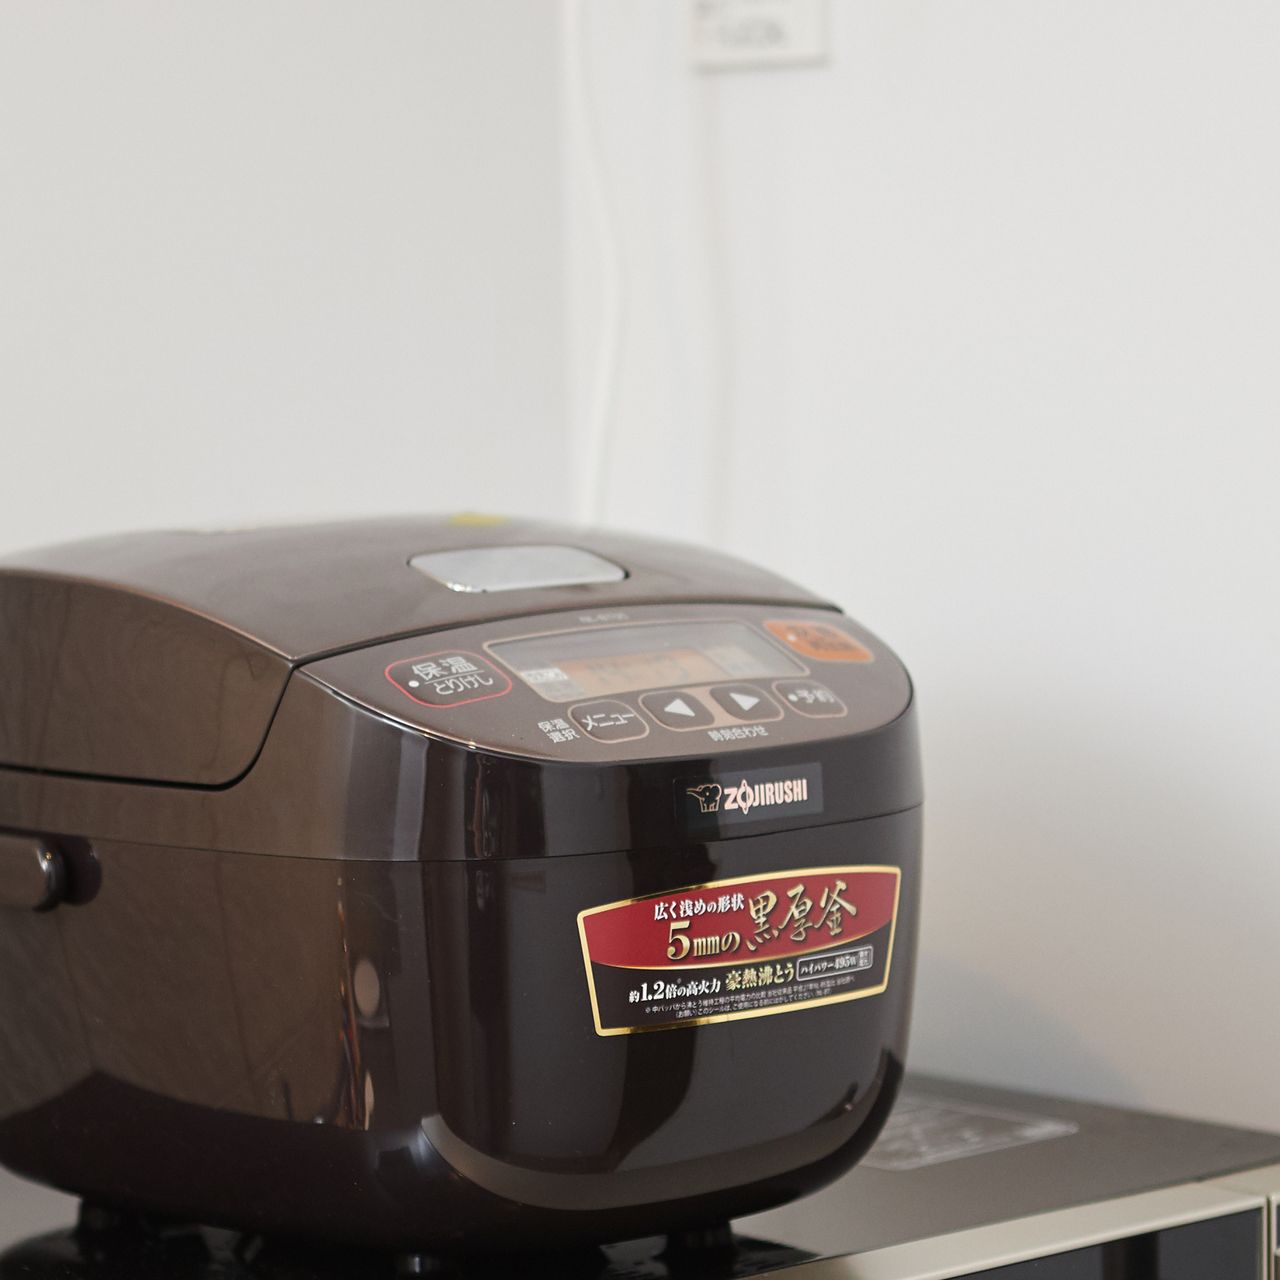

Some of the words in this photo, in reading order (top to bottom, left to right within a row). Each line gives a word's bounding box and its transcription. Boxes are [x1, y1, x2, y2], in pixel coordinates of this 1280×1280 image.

[412, 656, 478, 681] 保温
[433, 674, 494, 695] とりけし
[537, 718, 571, 733] 保温
[582, 713, 634, 731] メニュー
[707, 725, 769, 742] 時刻合わせ
[546, 728, 581, 743] 選択
[724, 779, 808, 815] ZOJIRUSHI
[654, 892, 745, 921] 広く浅めの形状
[746, 880, 858, 951] 黒厚釜
[726, 962, 795, 991] 豪熱沸とう
